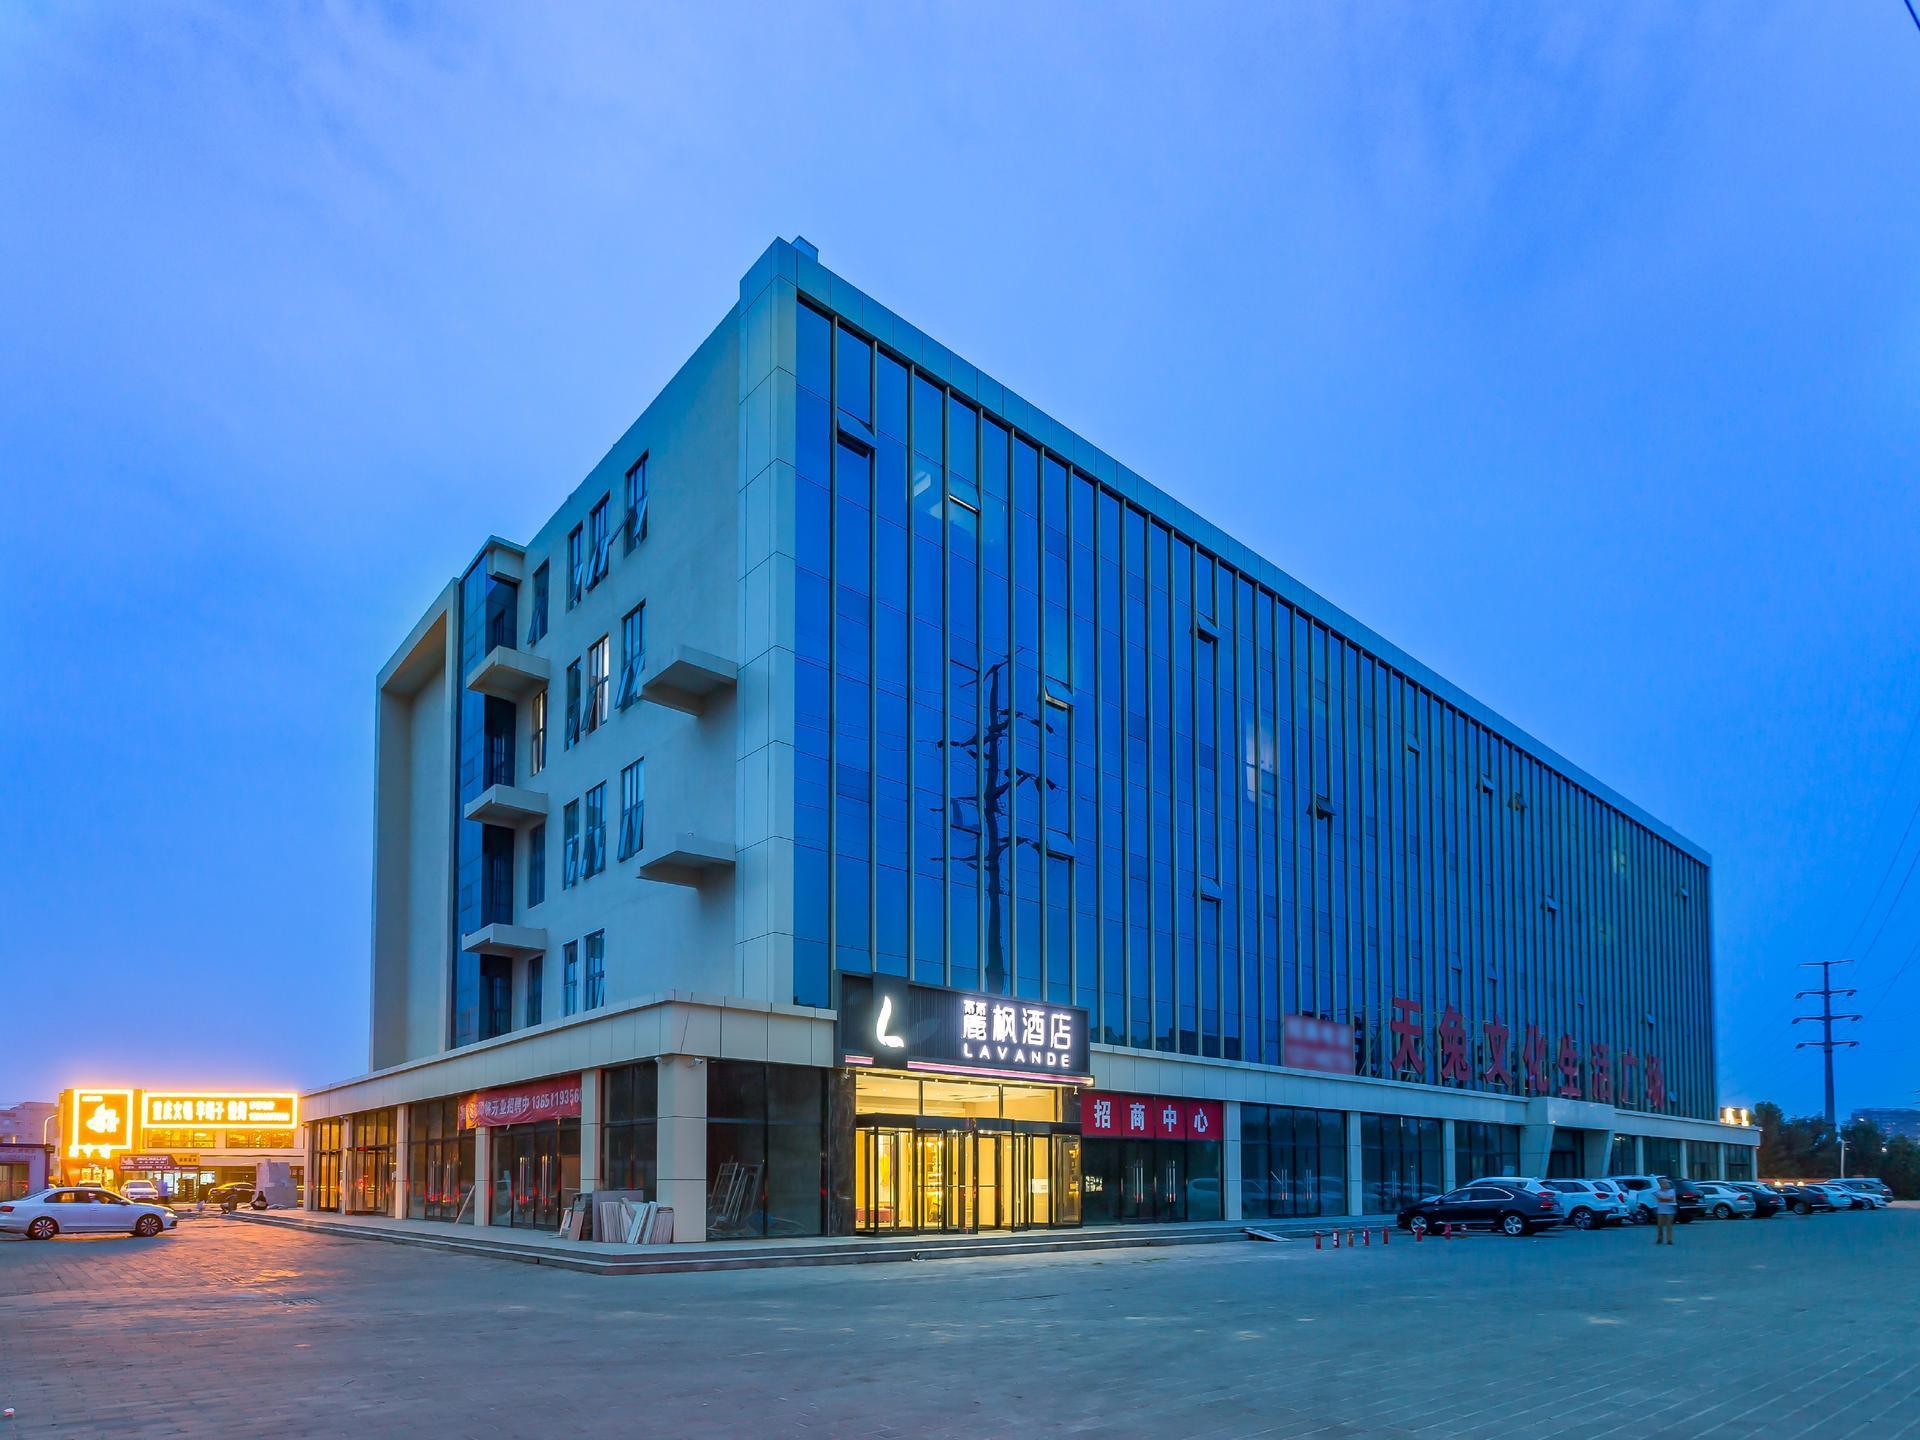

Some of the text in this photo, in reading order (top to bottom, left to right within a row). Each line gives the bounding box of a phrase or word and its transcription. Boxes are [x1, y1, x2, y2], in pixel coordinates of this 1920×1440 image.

[962, 999, 1073, 1050] 麗枫酒店
[963, 1043, 1071, 1068] LAVANDE
[1390, 997, 1664, 1109] 天兔文化生活广场
[1093, 1099, 1209, 1133] 招商中心
